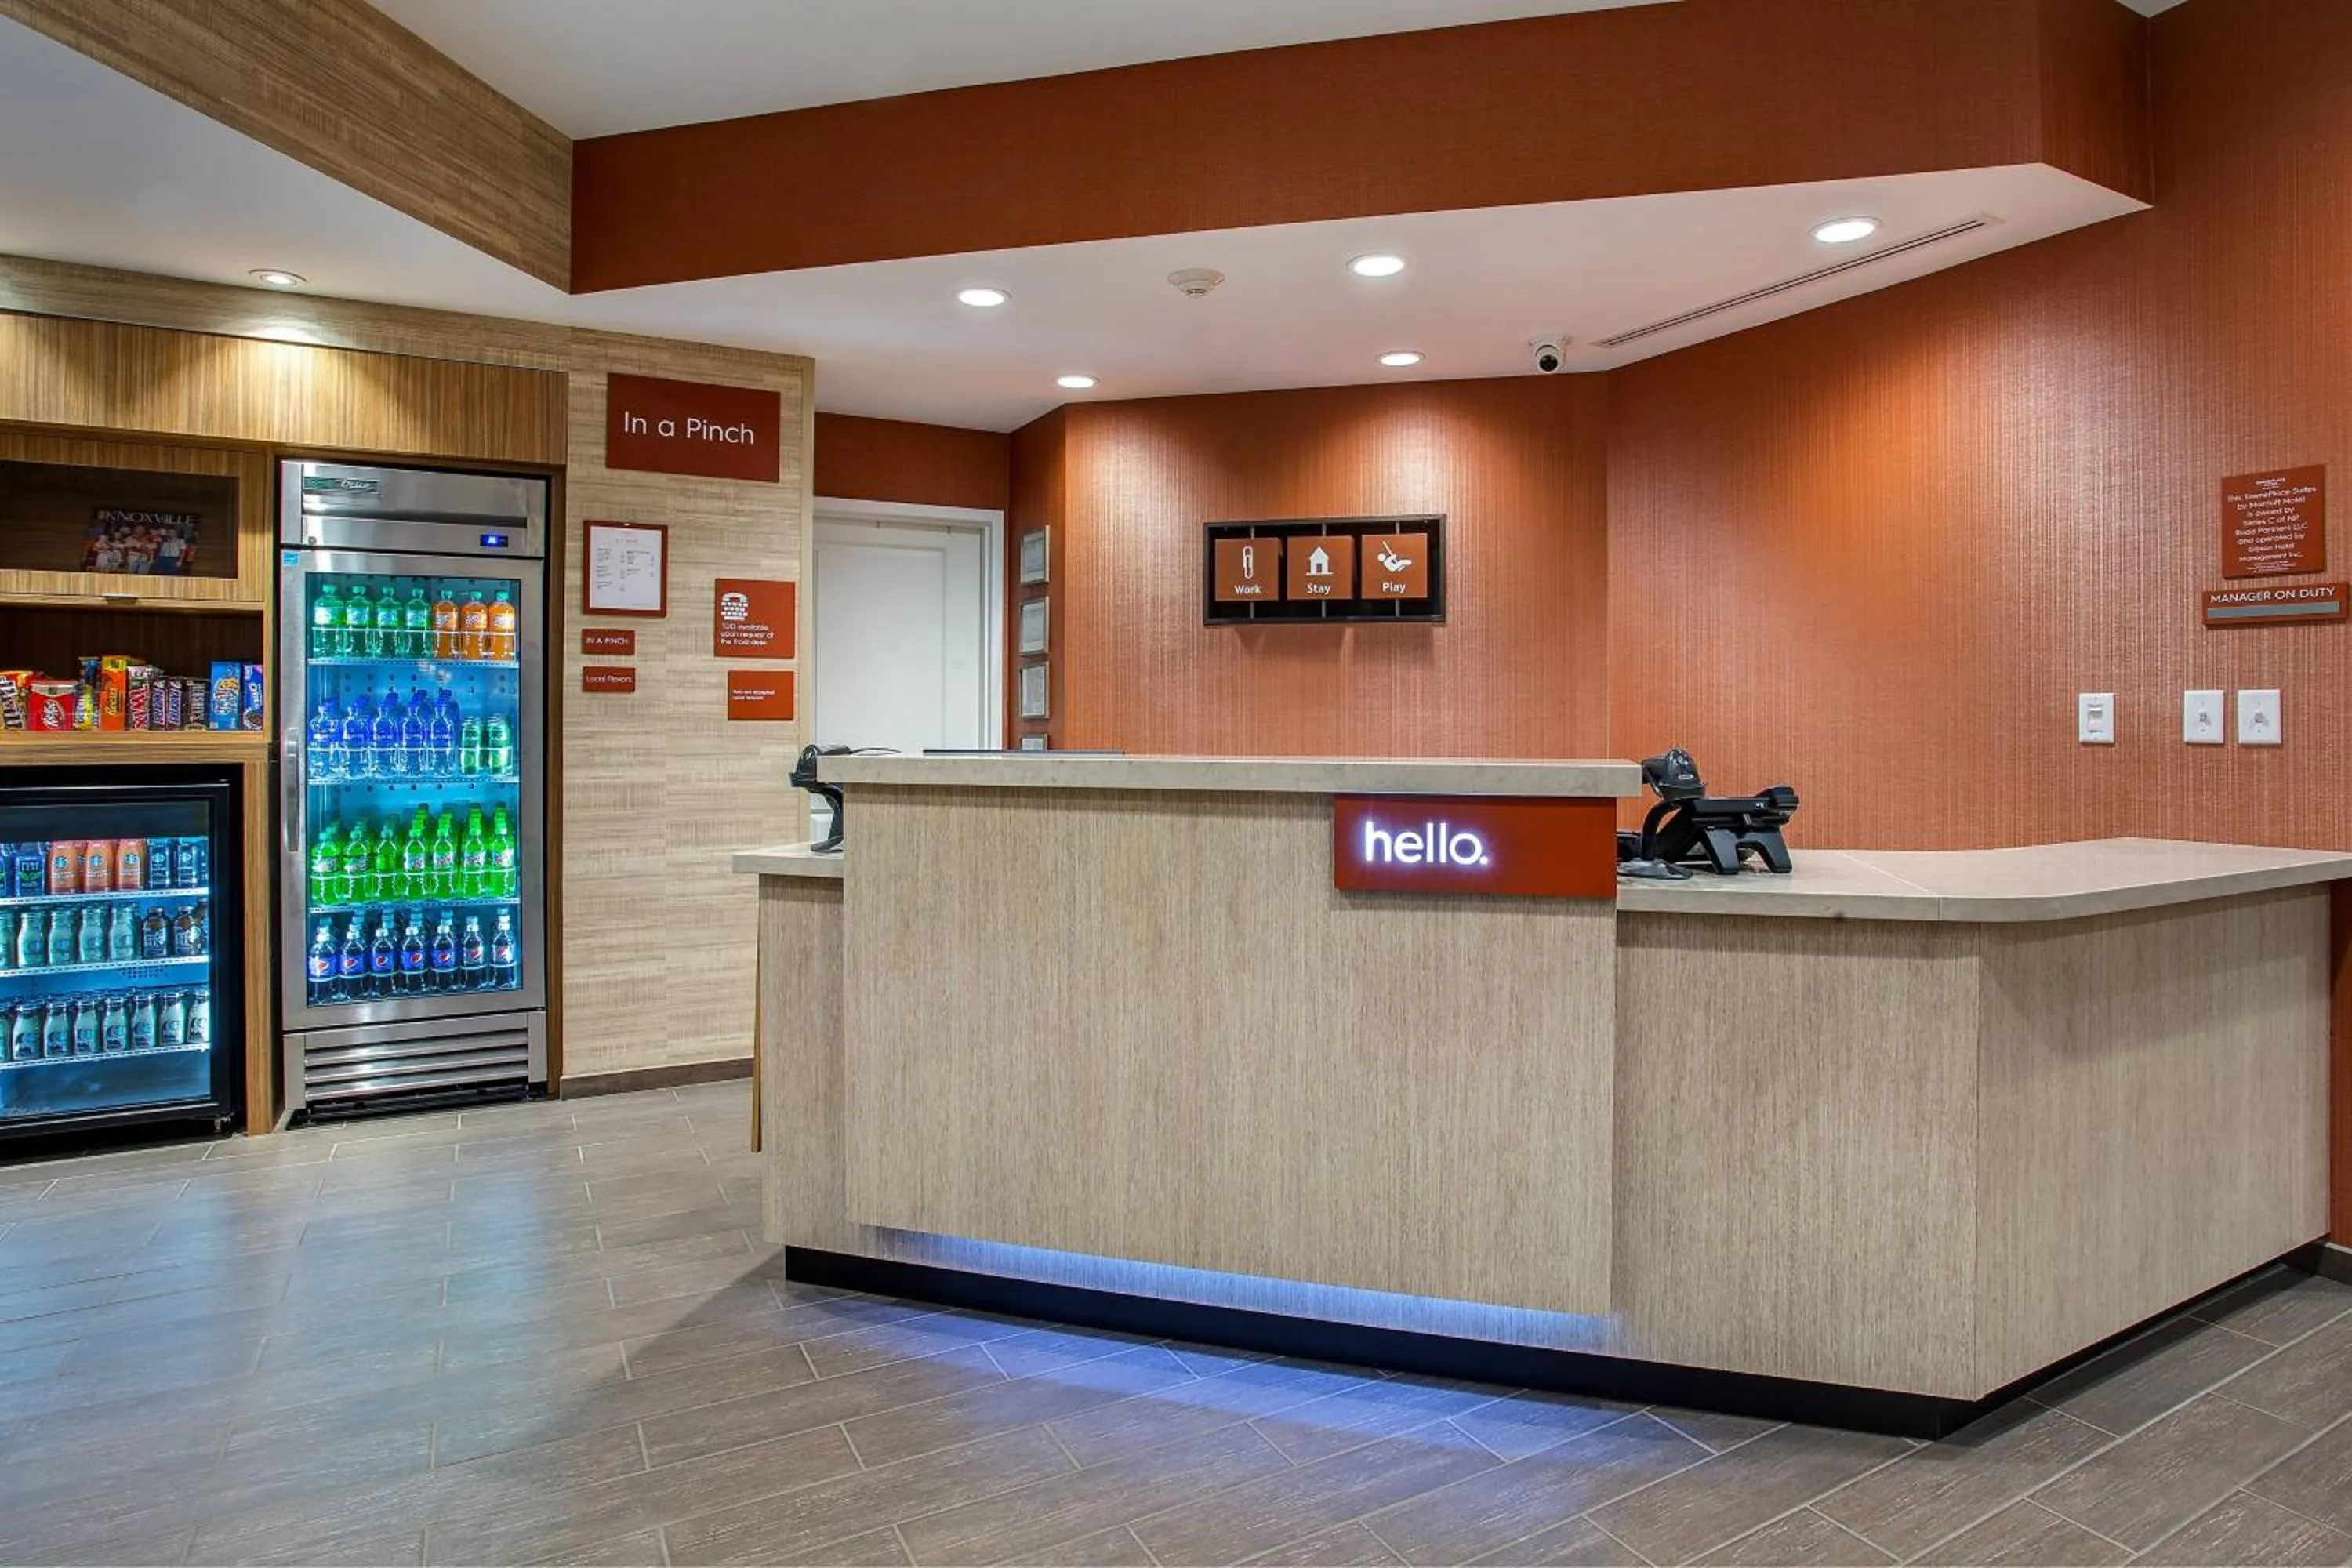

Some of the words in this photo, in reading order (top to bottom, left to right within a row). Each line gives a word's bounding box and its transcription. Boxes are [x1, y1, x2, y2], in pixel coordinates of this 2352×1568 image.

[624, 410, 647, 434] In
[658, 419, 676, 437] a
[686, 417, 754, 445] Pinch
[105, 510, 194, 524] KNOXVILLE
[2255, 508, 2282, 517] owned
[1234, 584, 1262, 594] Work
[1306, 583, 1331, 595] Stay
[1382, 581, 1406, 593] Play
[2210, 590, 2272, 603] MANAGER
[2274, 590, 2296, 600] ON
[2299, 586, 2336, 598] DUTY
[1365, 821, 1489, 866] hello.
